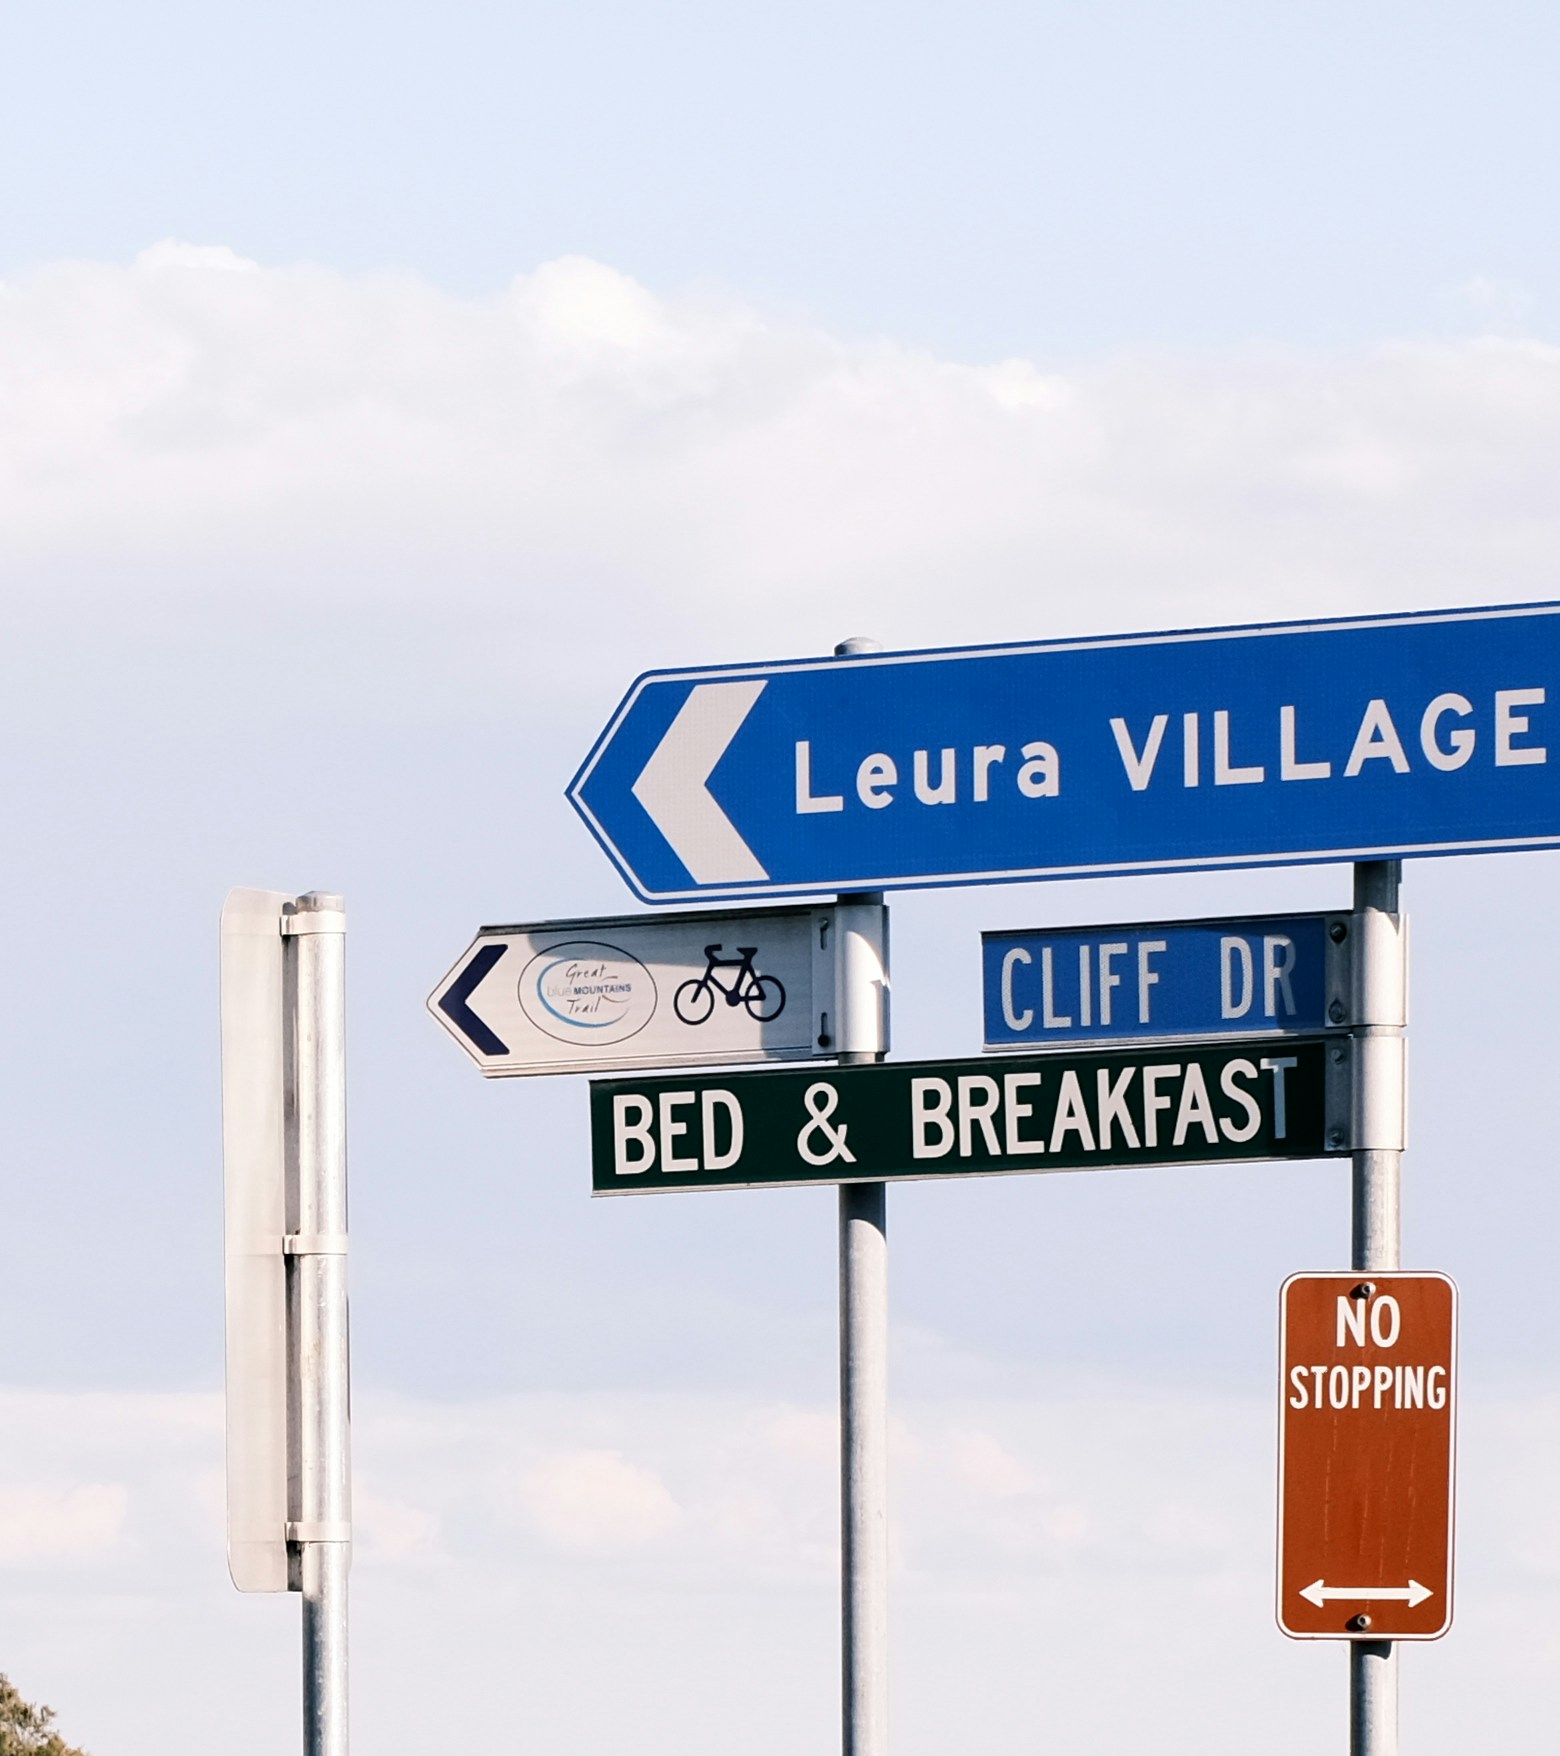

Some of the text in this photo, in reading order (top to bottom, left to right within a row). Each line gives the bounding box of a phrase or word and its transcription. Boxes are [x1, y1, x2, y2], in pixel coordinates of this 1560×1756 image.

[794, 687, 1548, 815] Leura VILLAGE
[565, 963, 606, 985] Great
[573, 983, 632, 996] MOUNTAINS
[1000, 933, 1297, 1031] CLIFF DR
[566, 996, 601, 1015] Trail
[613, 1056, 1298, 1177] BED & BREAKFAST
[1336, 1295, 1401, 1349] NO
[1289, 1365, 1447, 1410] STOPPING
